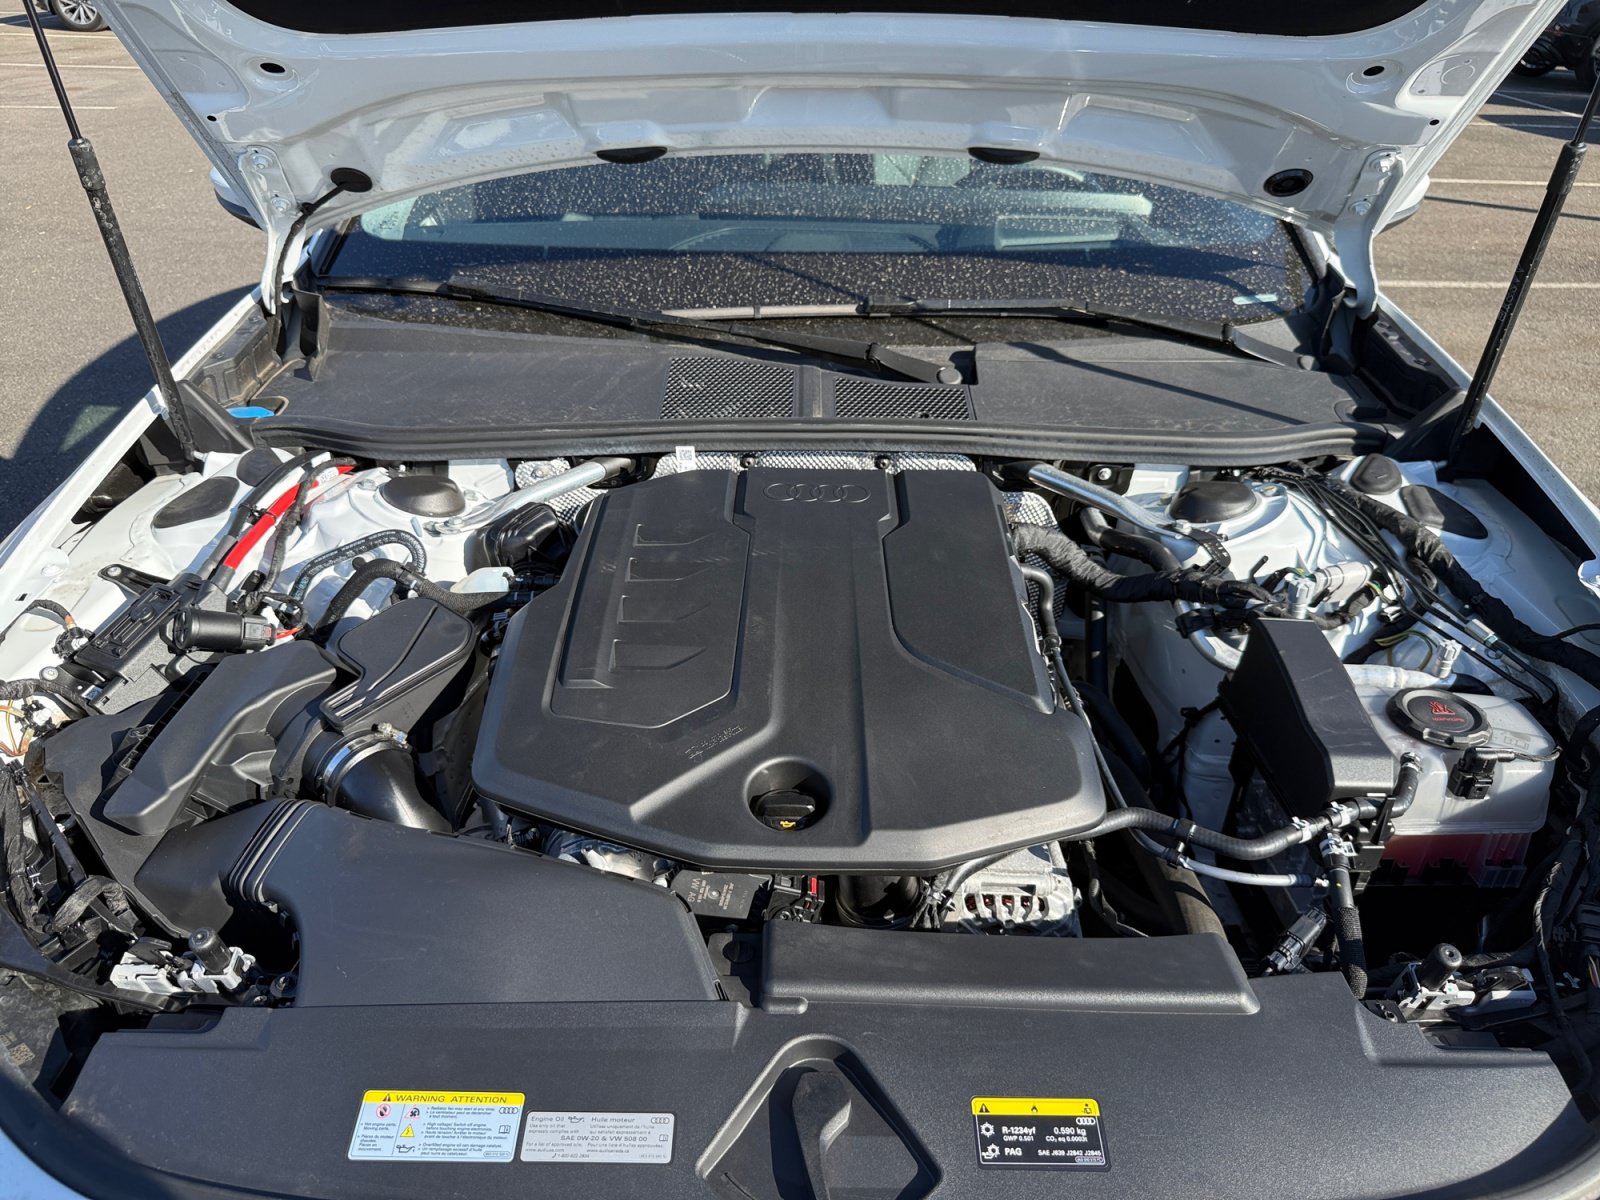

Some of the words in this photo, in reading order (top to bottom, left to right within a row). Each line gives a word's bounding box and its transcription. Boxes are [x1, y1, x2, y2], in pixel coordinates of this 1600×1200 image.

[691, 878, 700, 890] VW
[688, 892, 696, 902] AG
[1002, 1126, 1036, 1135] R-1234yf
[1076, 1127, 1086, 1135] kg
[1005, 1148, 1022, 1156] PAG
